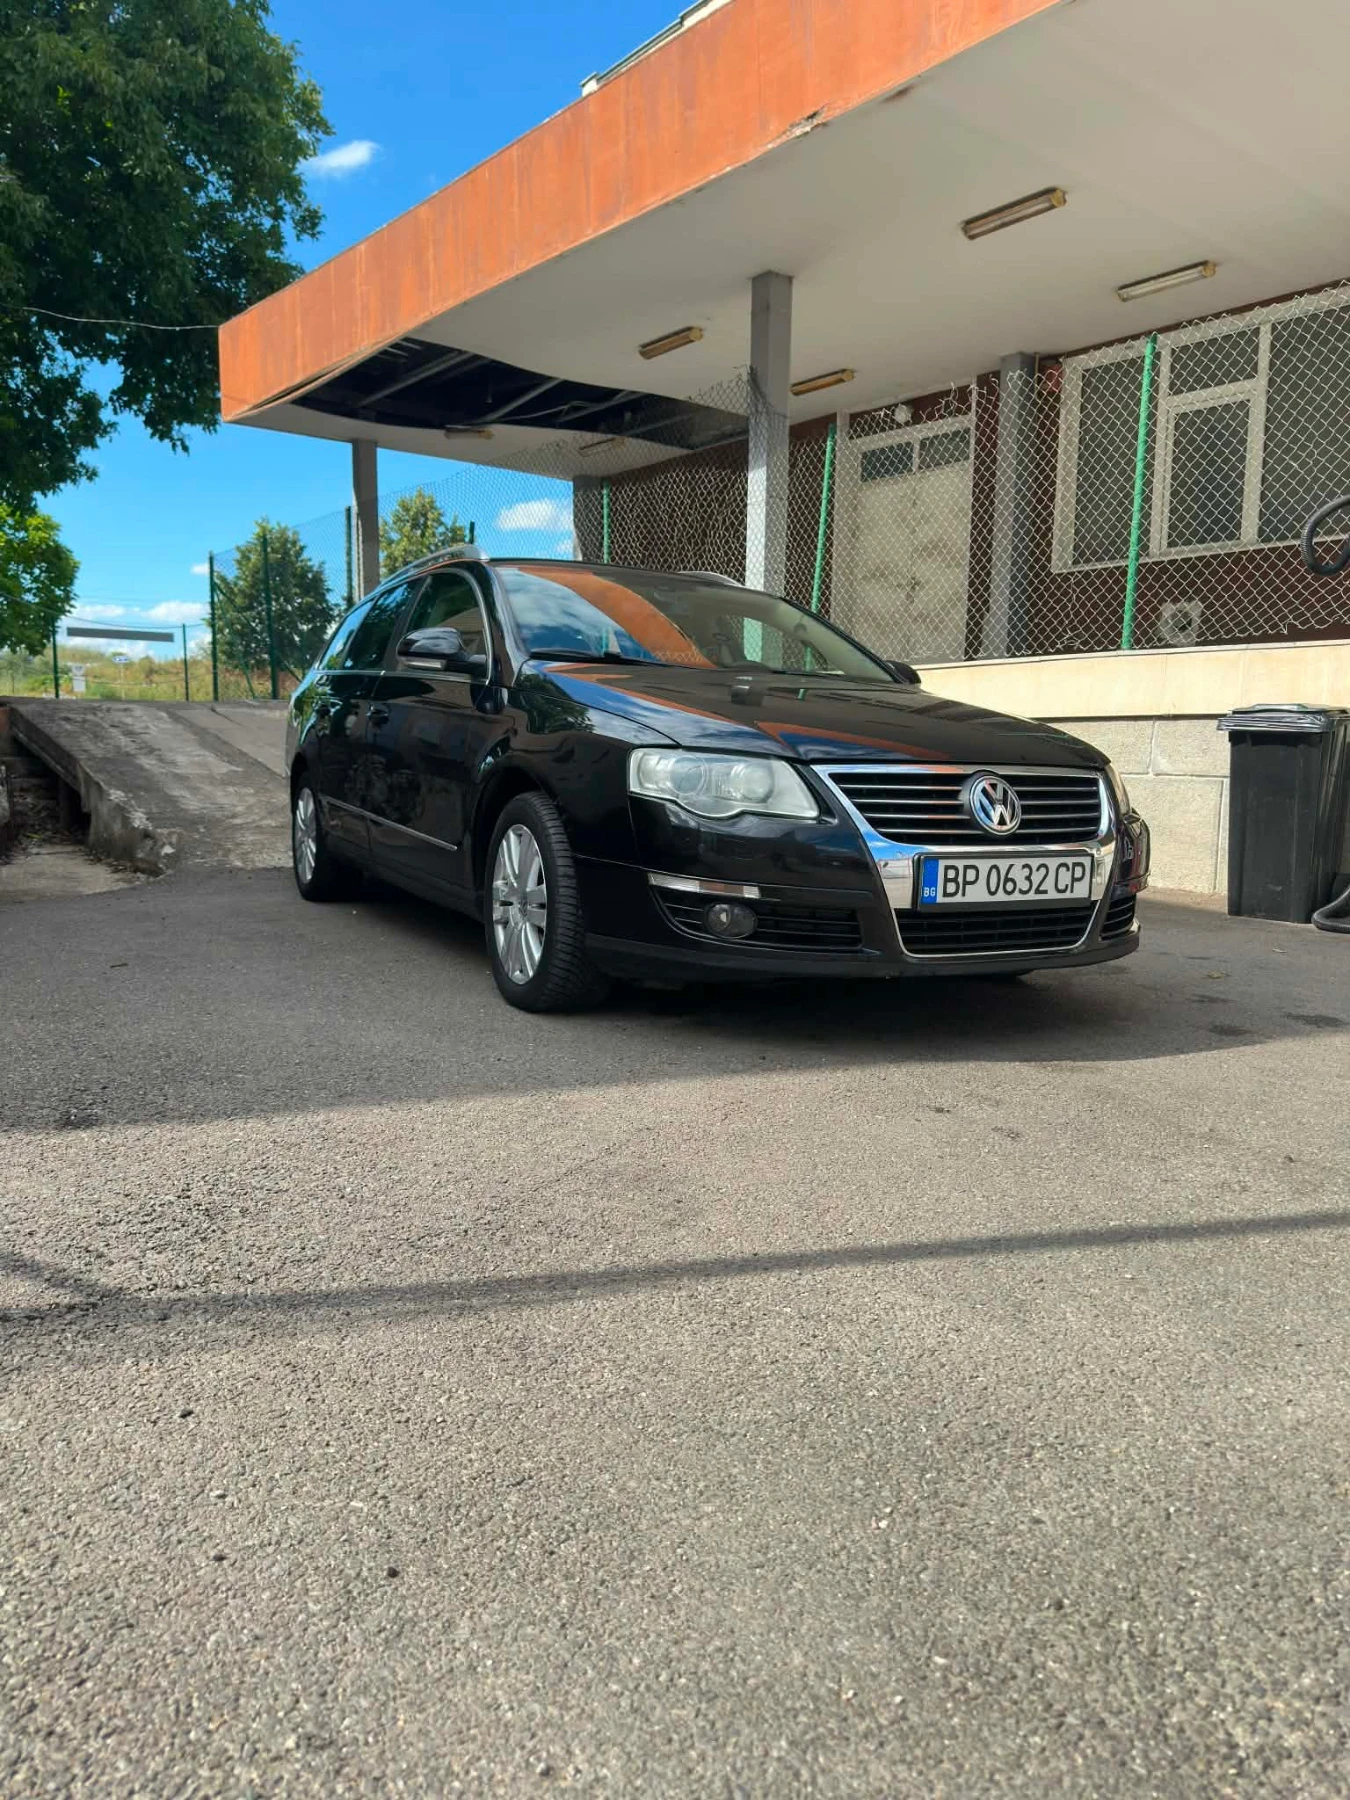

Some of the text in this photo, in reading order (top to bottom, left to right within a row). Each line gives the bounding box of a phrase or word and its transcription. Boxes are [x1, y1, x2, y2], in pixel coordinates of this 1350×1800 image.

[973, 779, 1018, 830] VW
[923, 886, 936, 897] BG
[942, 861, 1086, 898] BP 0632 CP
